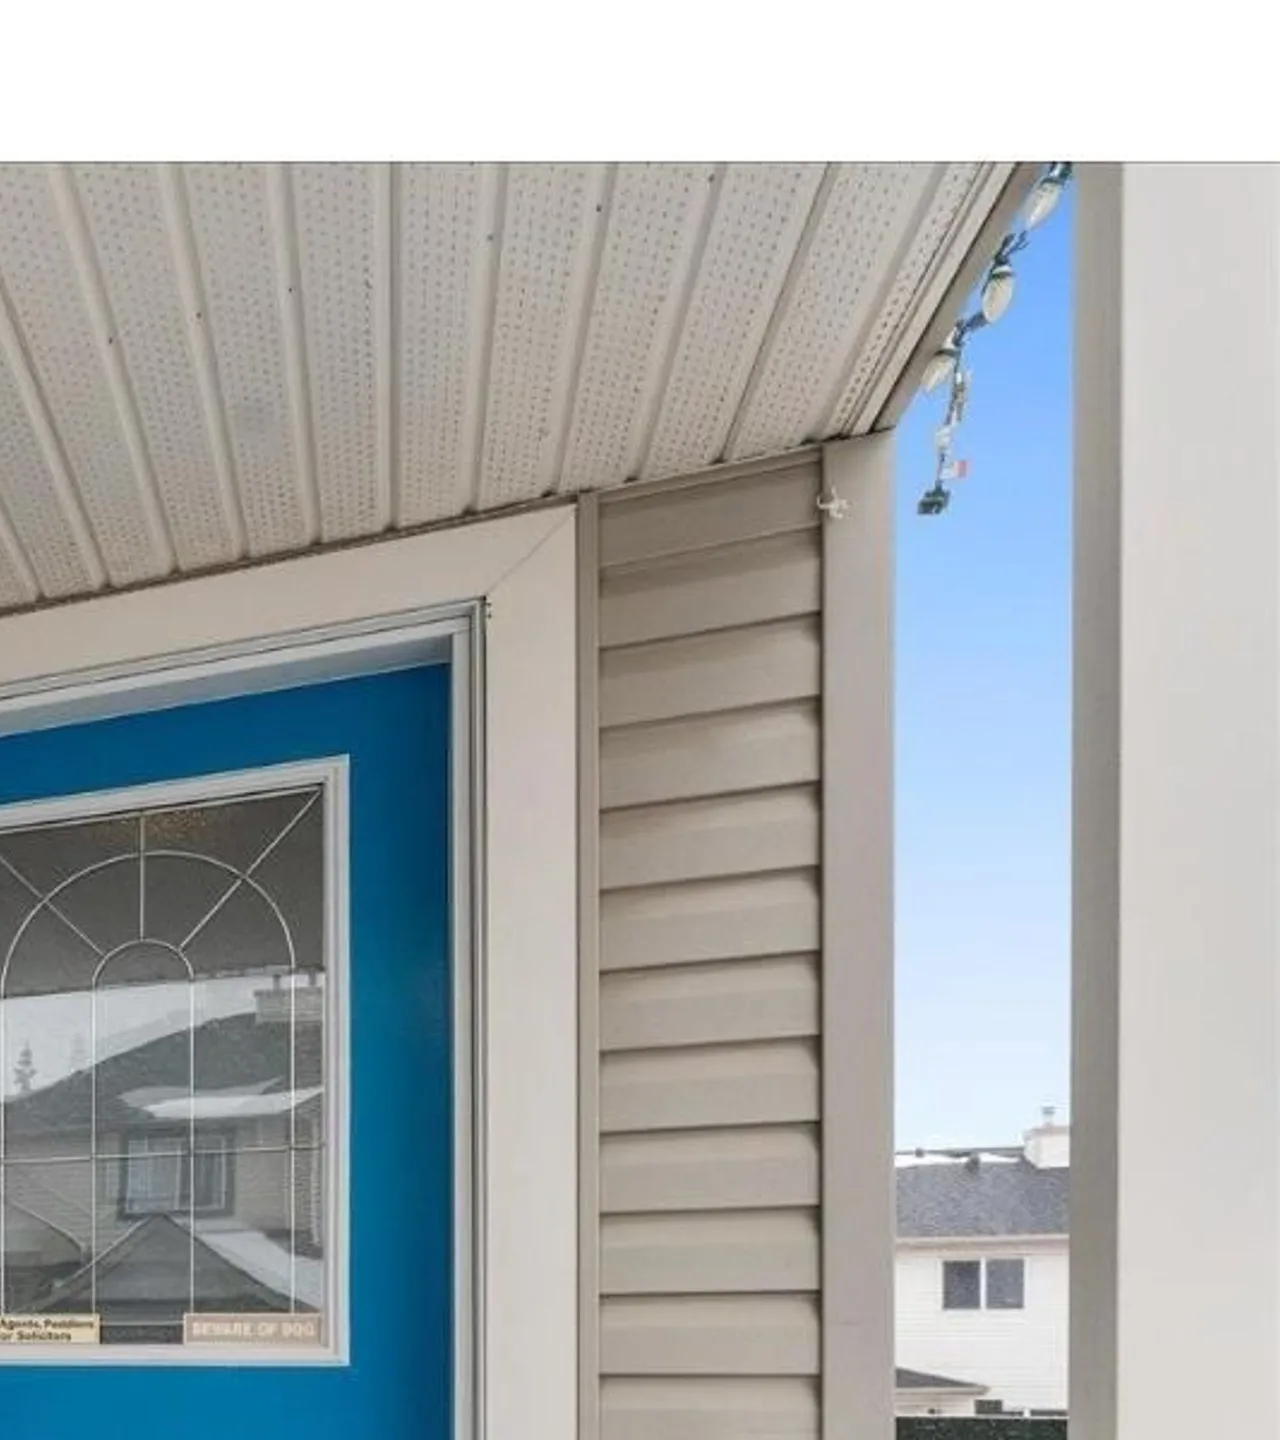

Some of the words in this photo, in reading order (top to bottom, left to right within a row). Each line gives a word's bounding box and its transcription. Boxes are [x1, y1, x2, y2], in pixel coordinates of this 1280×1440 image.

[192, 1321, 252, 1336] BEWARE
[258, 1321, 278, 1336] OF
[281, 1321, 315, 1338] DOG
